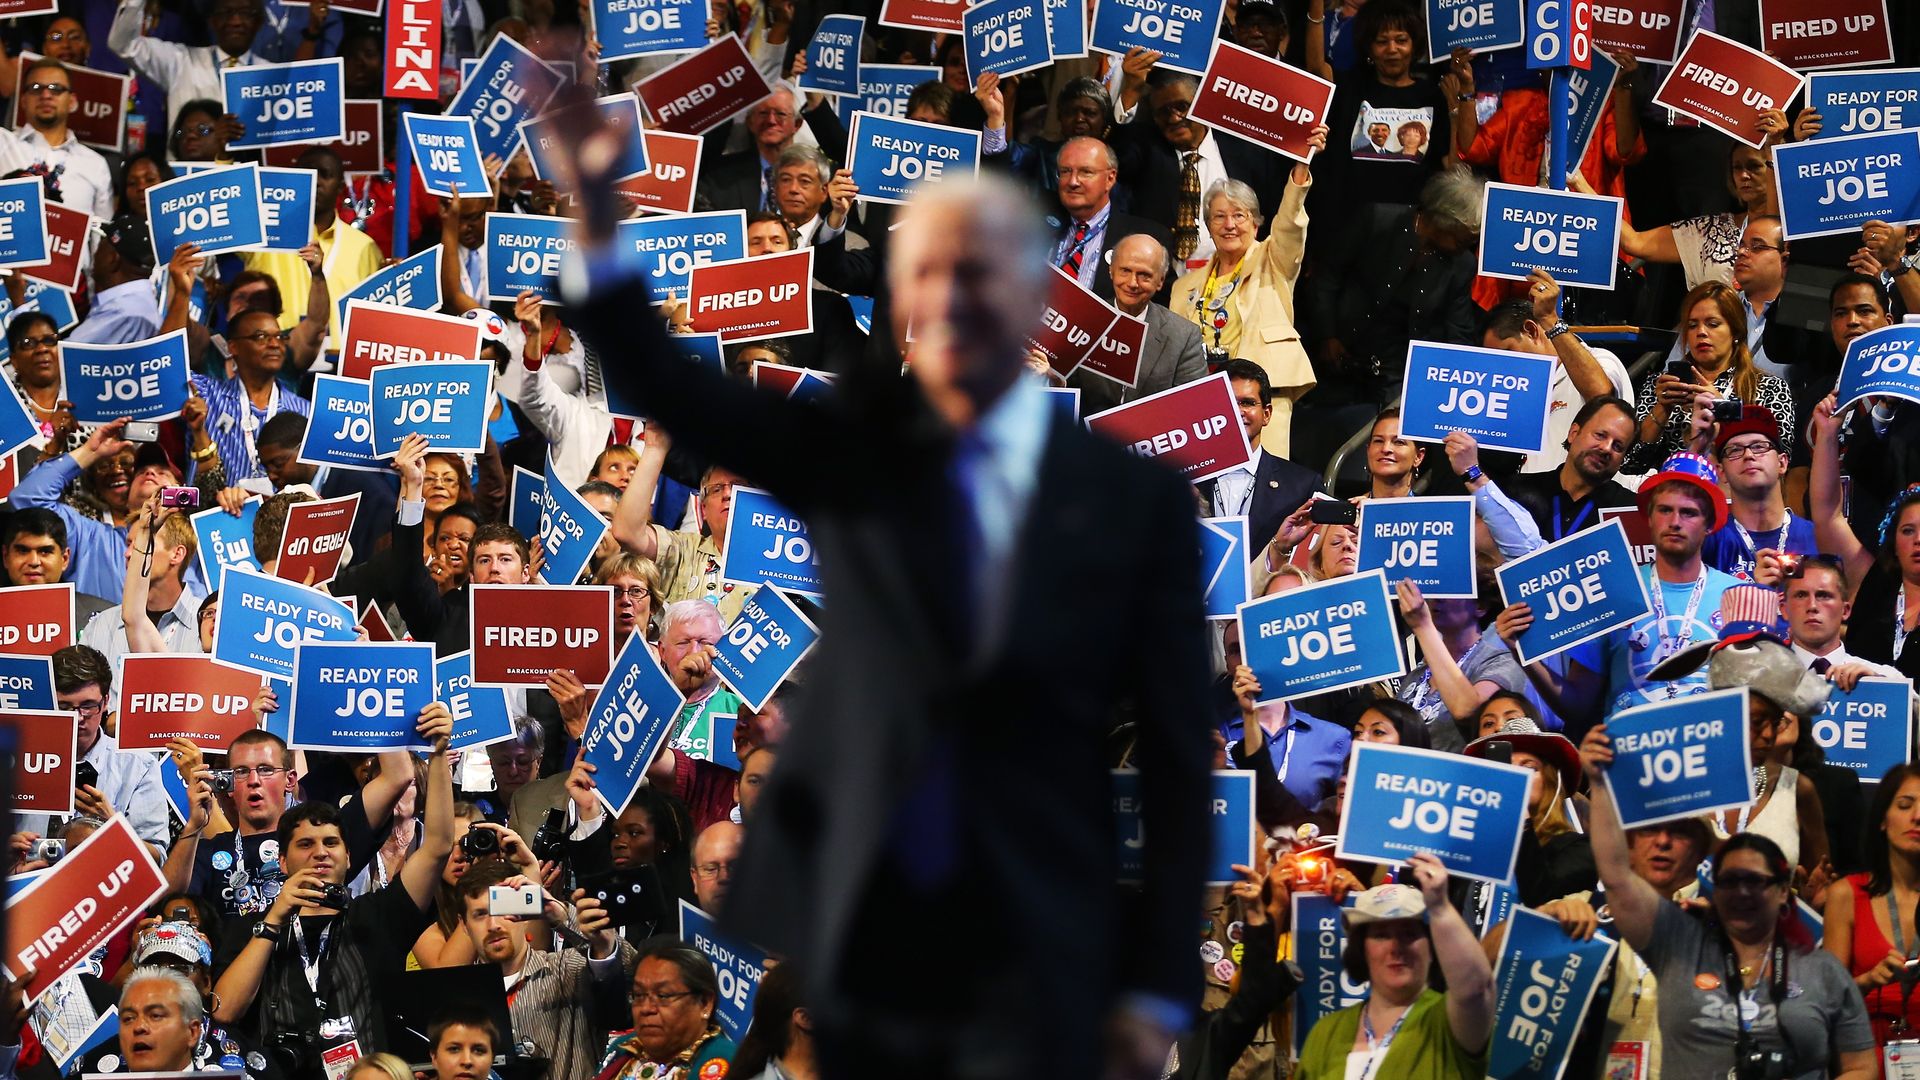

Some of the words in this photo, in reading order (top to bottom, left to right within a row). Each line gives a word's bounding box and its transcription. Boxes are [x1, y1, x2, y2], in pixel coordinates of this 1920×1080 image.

[624, 8, 680, 34] JOE
[973, 14, 1004, 36] READY
[1008, 6, 1032, 22] FOR
[1171, 5, 1202, 22] FOR
[1448, 2, 1494, 31] JOE
[1640, 12, 1670, 30] UP
[837, 34, 853, 46] FOR
[1123, 12, 1184, 46] JOE
[1772, 19, 1837, 40] FIRED
[1844, 15, 1875, 32] UP
[393, 0, 432, 91] LINA
[981, 25, 1024, 58] JOE
[816, 46, 844, 70] JOE
[1795, 50, 1858, 60] BARACKOBAMA.COM
[490, 61, 514, 89] FOR
[1681, 62, 1739, 95] FIRED
[1742, 88, 1773, 110] UP
[241, 84, 291, 98] READY
[296, 80, 325, 93] FOR
[658, 84, 715, 122] FIRED
[717, 66, 745, 87] UP
[860, 82, 892, 96] EADY
[1212, 76, 1278, 112] FIRED
[1284, 103, 1314, 124] UP
[1828, 92, 1880, 105] READY
[1886, 90, 1917, 102] FOR
[86, 103, 112, 118] UP
[257, 96, 313, 122] JOE
[482, 80, 526, 138] JOE
[1684, 98, 1738, 126] BARACKOBAMA.COM
[1841, 106, 1902, 132] JOE
[417, 134, 442, 146] READY
[444, 136, 465, 148] FOR
[1223, 116, 1283, 141] BARACKOBAMA.COM
[872, 135, 923, 154] READY
[928, 145, 959, 160] FOR
[430, 150, 461, 172] JOE
[655, 164, 686, 181] UP
[882, 155, 945, 182] JOE
[1798, 158, 1858, 178] READY
[1865, 154, 1902, 169] FOR
[162, 192, 206, 216] READY
[210, 186, 240, 201] FOR
[264, 188, 296, 201] FOR
[1818, 172, 1888, 204] JOE
[174, 203, 230, 234] JOE
[1503, 208, 1558, 225] READY
[1563, 215, 1597, 230] FOR
[1820, 209, 1892, 222] BARACKOBAMA.COM
[498, 234, 542, 248] READY
[546, 237, 576, 252] FOR
[636, 236, 688, 252] READY
[694, 233, 726, 246] FOR
[1514, 228, 1579, 256] JOE
[396, 266, 422, 286] FOR
[507, 248, 563, 279] JOE
[652, 250, 713, 278] JOE
[1512, 262, 1578, 274] BARACKOBAMA.COM
[699, 289, 762, 312] FIRED
[770, 283, 799, 302] UP
[718, 320, 779, 331] BARACKOBAMA.COM
[1068, 326, 1090, 346] UP
[355, 340, 426, 364] FIRED
[1097, 333, 1130, 355] UP
[1858, 340, 1914, 360] READY
[81, 364, 134, 376] READY
[141, 356, 171, 373] FOR
[1427, 367, 1487, 385] READY
[1492, 374, 1529, 391] FOR
[97, 374, 160, 401] JOE
[385, 383, 432, 398] READY
[437, 382, 470, 394] FOR
[1856, 380, 1920, 391] BARACKOBAMA.CO
[97, 404, 162, 414] BARACKOBAMA.COM
[328, 398, 371, 416] READY
[394, 399, 452, 425] JOE
[1438, 390, 1510, 418] JOE
[334, 418, 371, 442] JO
[1193, 416, 1227, 440] UP
[1434, 424, 1506, 438] BARACKOBAMA.COM
[540, 513, 566, 556] OE
[560, 515, 584, 541] FOR
[1375, 522, 1418, 537] READY
[1423, 522, 1453, 535] FOR
[288, 538, 309, 555] UP
[313, 531, 346, 553] FIRED
[763, 534, 816, 564] JO
[1384, 540, 1438, 568] JOE
[1519, 565, 1571, 598] READY
[1575, 550, 1611, 574] FOR
[1544, 574, 1606, 620] JOE
[242, 593, 302, 619] READY
[308, 610, 342, 630] FOR
[1260, 610, 1323, 639] READY
[1326, 601, 1366, 622] FOR
[28, 624, 60, 642] UP
[255, 618, 324, 644] JOE
[485, 627, 557, 646] FIRED
[565, 628, 598, 647] UP
[764, 620, 791, 650] FOR
[1550, 610, 1615, 640] BARACKOBAMA.COM
[724, 618, 770, 664] JOE
[1281, 624, 1356, 666] JOE
[250, 652, 294, 668] BARACKOBA.
[320, 668, 381, 683] READY
[387, 669, 418, 683] FOR
[1286, 665, 1362, 686] BARACKOBAMA.COM
[131, 694, 204, 712] FIRED
[212, 695, 248, 714] UP
[335, 688, 404, 717] JOE
[587, 696, 619, 753] READY
[618, 664, 640, 699] FOR
[1847, 702, 1886, 717] FOR
[150, 732, 220, 741] BARACKOBAMA.COM
[606, 691, 650, 762] JOE
[1616, 728, 1677, 752] READY
[1684, 720, 1723, 742] FOR
[1812, 720, 1868, 748] OE
[626, 717, 660, 778] BARACKOBAMA.COM
[24, 753, 60, 773] UP
[1640, 744, 1707, 786] JOE
[1376, 773, 1451, 798] READY
[1456, 786, 1501, 808] FOR
[1390, 798, 1478, 840] JOE
[18, 898, 98, 972] FIRED
[98, 860, 134, 897] UP
[58, 906, 128, 970] BARACKOBAMA.COM
[694, 934, 734, 966] READY
[1320, 918, 1335, 958] FOR
[1547, 953, 1582, 1024] READY
[1508, 960, 1545, 1046] JOE
